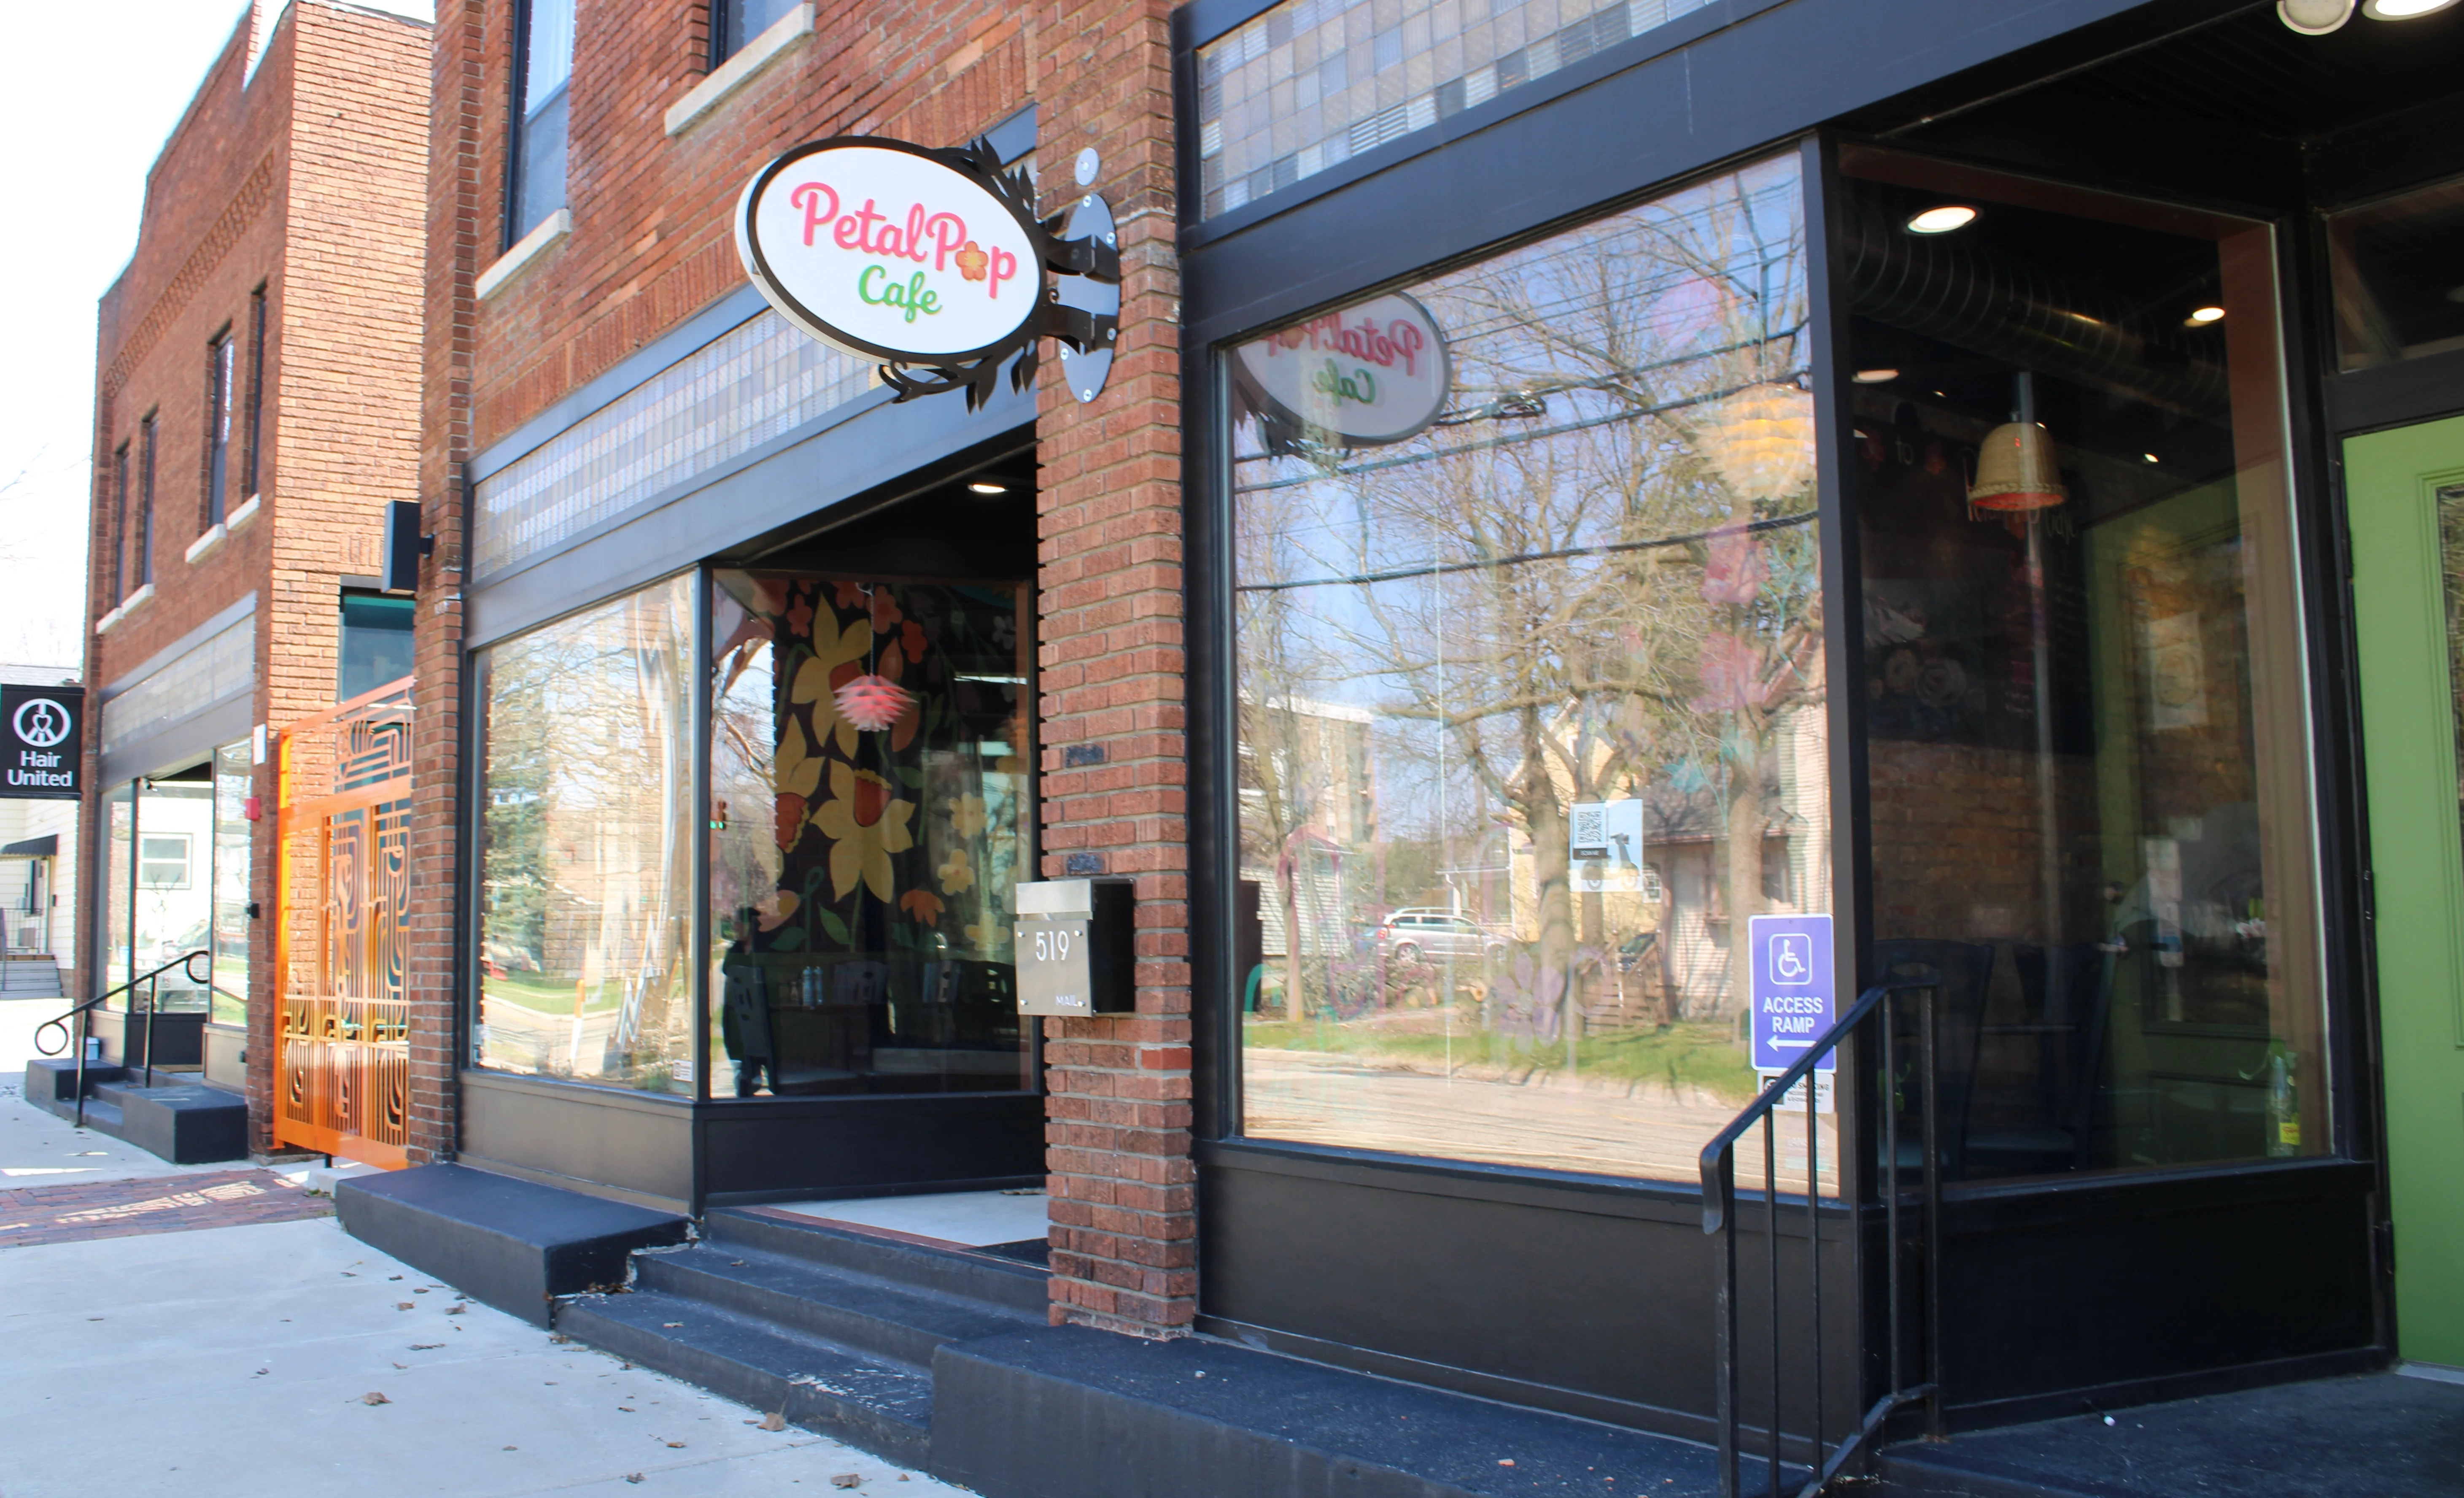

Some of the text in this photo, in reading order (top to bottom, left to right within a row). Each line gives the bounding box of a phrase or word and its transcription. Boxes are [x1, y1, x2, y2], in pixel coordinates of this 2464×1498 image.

[859, 265, 943, 323] Cafe
[20, 750, 62, 768] Hair
[7, 769, 73, 787] United
[1035, 931, 1069, 961] 519
[1055, 995, 1078, 1007] MAIL
[1763, 996, 1823, 1014] ACCESS
[1772, 1016, 1815, 1034] RAMP
